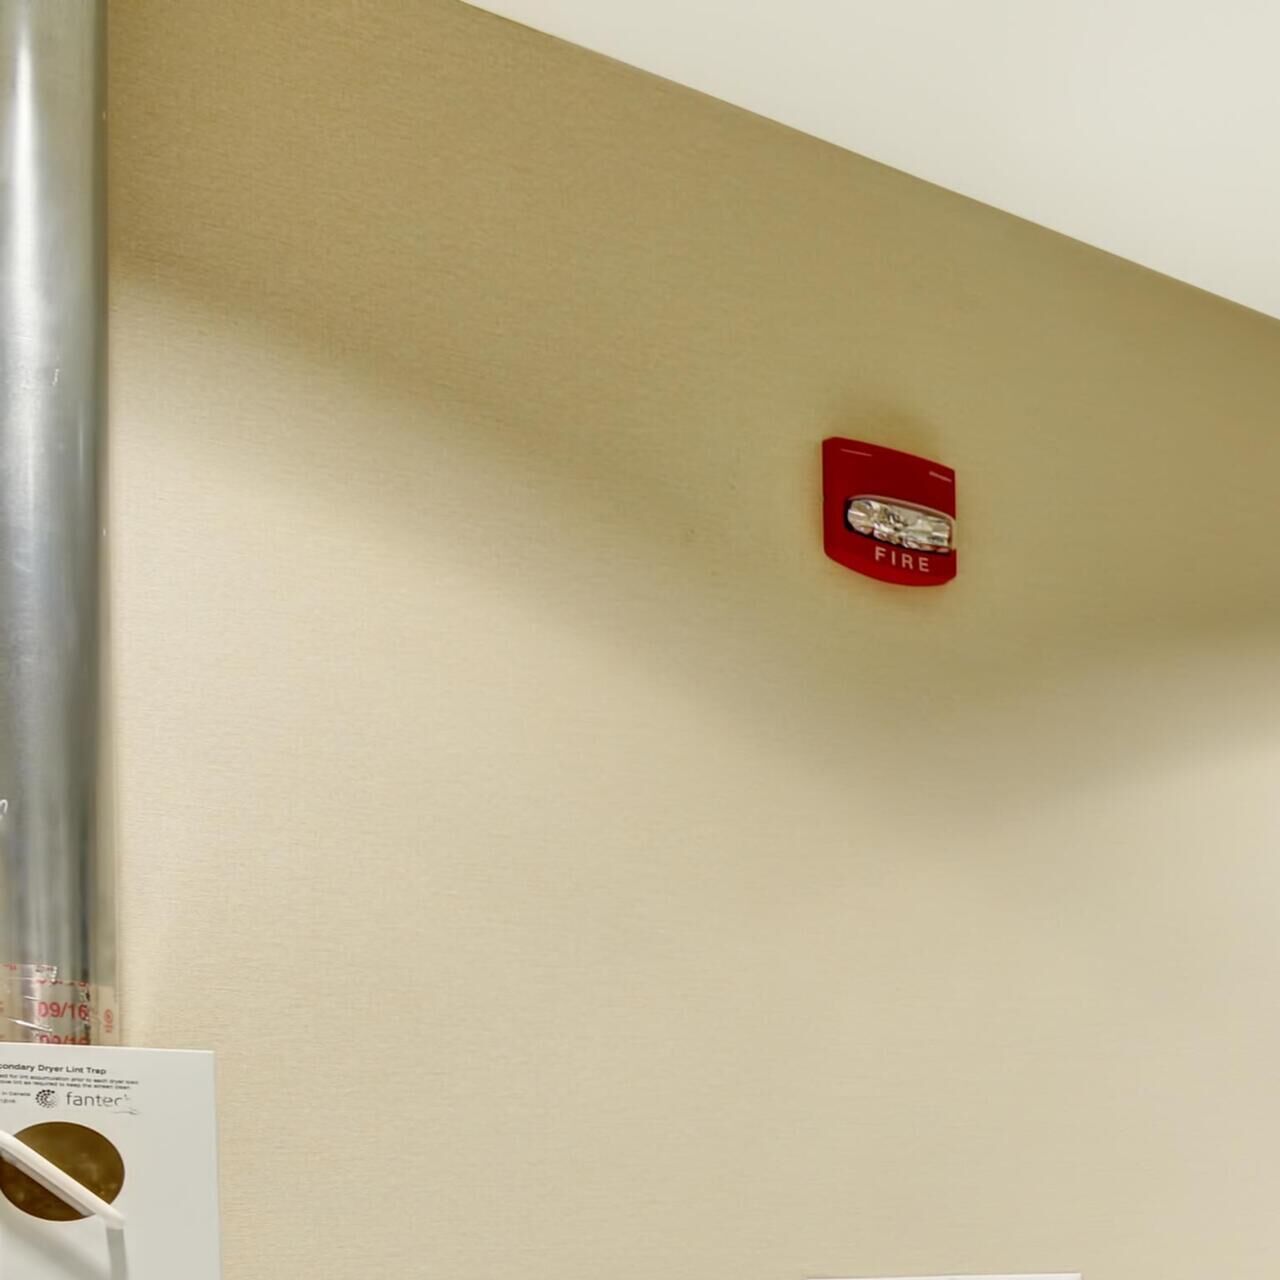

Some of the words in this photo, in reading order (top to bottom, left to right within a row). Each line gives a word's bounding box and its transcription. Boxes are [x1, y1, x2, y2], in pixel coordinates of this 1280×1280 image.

[874, 546, 929, 572] FIRE
[38, 1064, 63, 1073] Dryer
[66, 1065, 84, 1073] Lint
[86, 1066, 106, 1075] Trap
